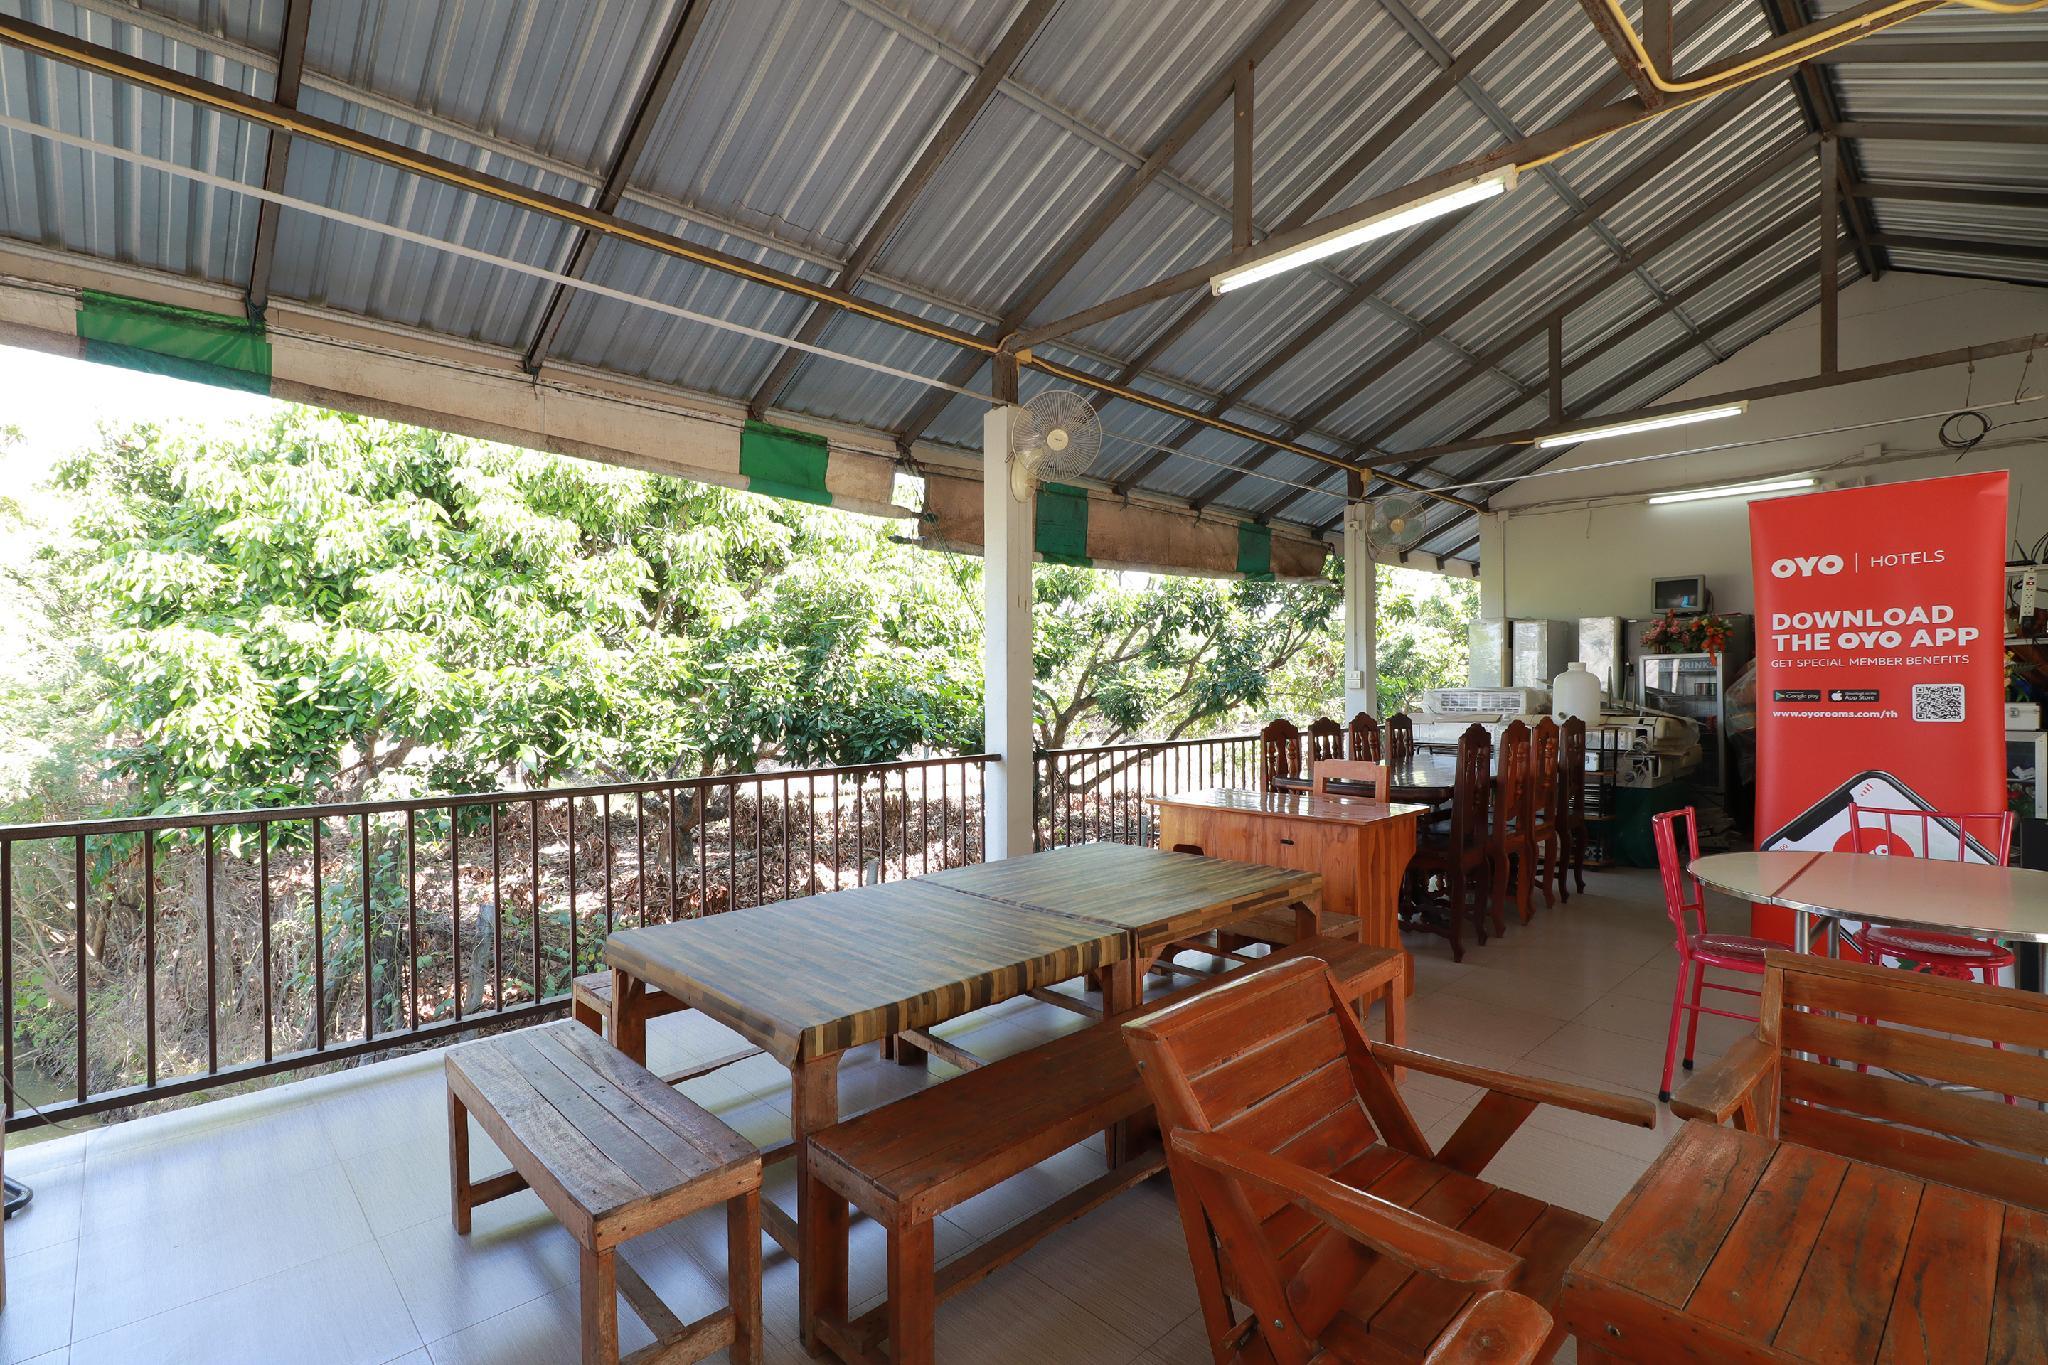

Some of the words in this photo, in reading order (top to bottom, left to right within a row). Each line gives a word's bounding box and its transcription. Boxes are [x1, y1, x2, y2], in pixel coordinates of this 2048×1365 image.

[1771, 555, 1843, 579] OYO
[1871, 549, 1945, 568] HOTELS
[1773, 605, 1954, 631] DOWNLOAD
[1772, 632, 1831, 651] THE
[1838, 631, 1902, 649] OYO
[1910, 628, 1980, 648] APP
[1771, 660, 1793, 668] GET
[1796, 658, 1845, 668] SPECIAL
[1850, 657, 1903, 667] MEMBER
[1906, 654, 1970, 666] BENEFITS
[1772, 709, 1898, 719] www.oyorooms.com/th
